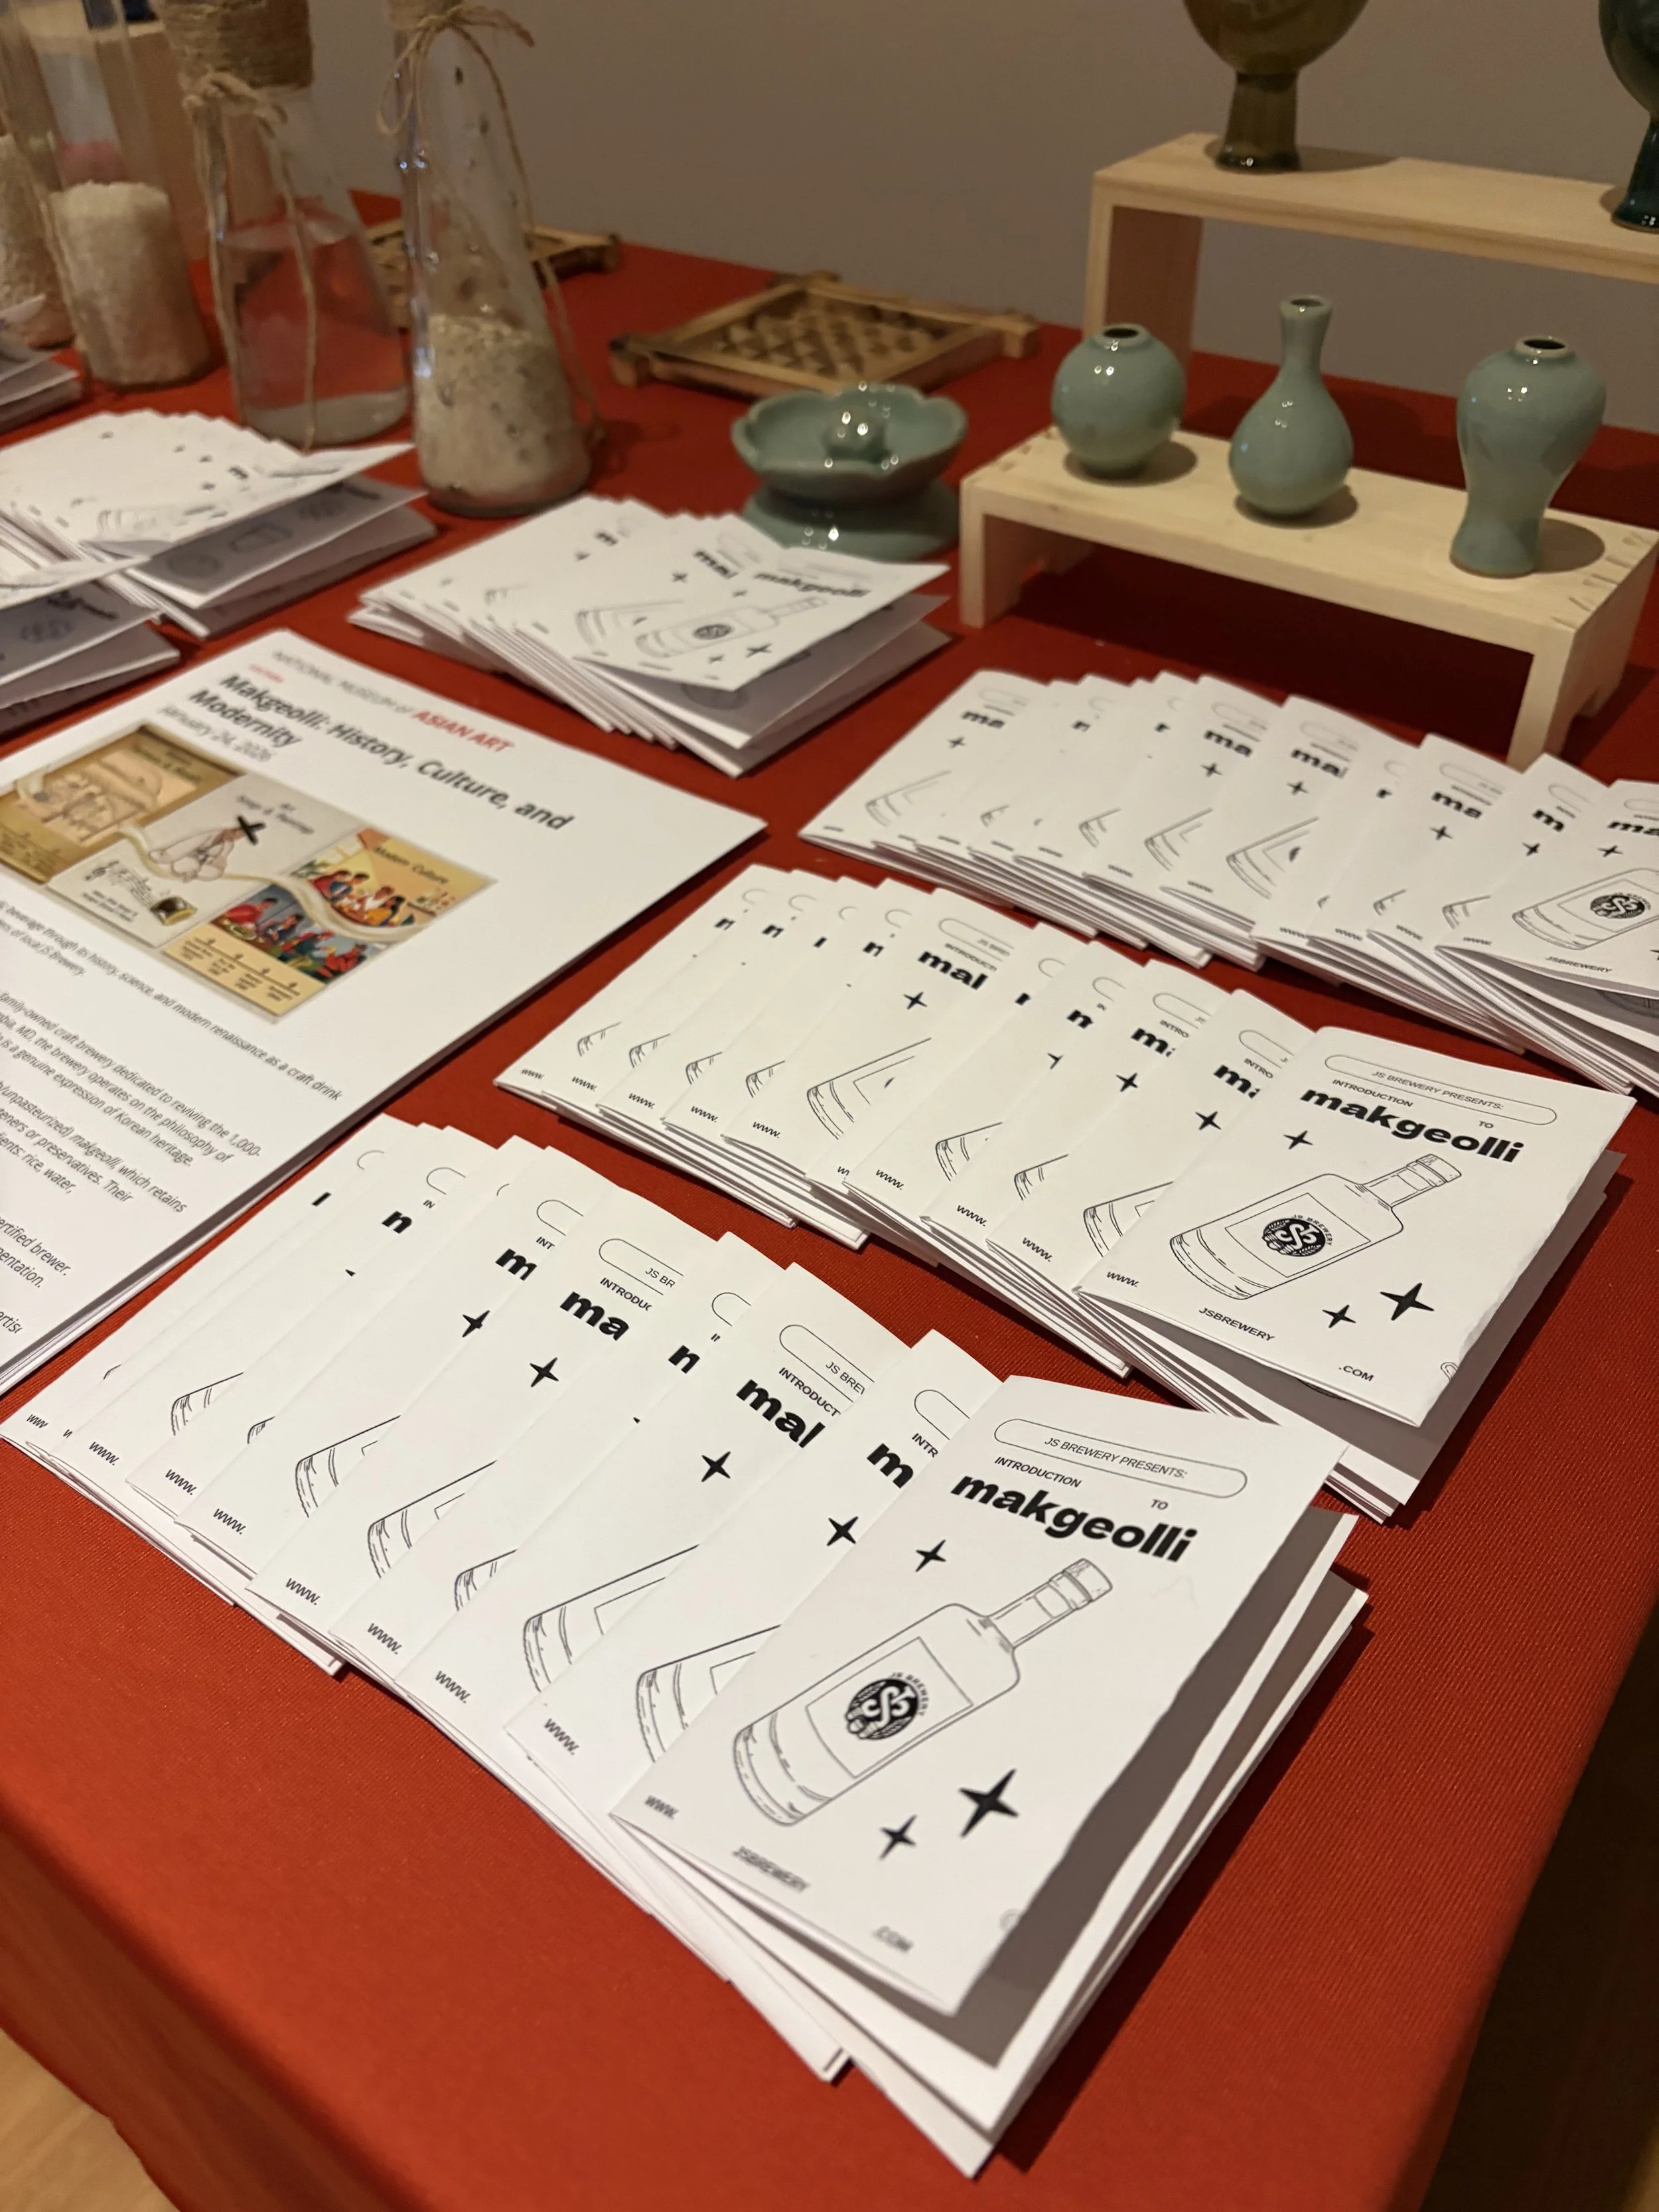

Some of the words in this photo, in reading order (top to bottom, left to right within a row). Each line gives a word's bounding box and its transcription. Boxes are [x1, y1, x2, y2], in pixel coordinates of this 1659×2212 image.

[188, 688, 303, 748] Modernity
[411, 710, 473, 738] ASIAN
[469, 732, 514, 752] ART
[220, 673, 330, 730] Makgeolli:
[325, 723, 414, 769] History,
[416, 759, 510, 810] Culture,
[514, 802, 575, 830] and
[411, 864, 450, 885] Culture
[1545, 956, 1613, 974] JSBREWERY
[42, 928, 79, 951] through
[86, 952, 119, 976] history,
[153, 993, 175, 1007] and
[172, 1001, 213, 1029] modern
[210, 1023, 267, 1060] renaissance
[265, 1055, 280, 1067] as
[277, 1062, 289, 1071] a
[286, 1067, 316, 1084] craft
[312, 1081, 343, 1101] drink
[9, 1045, 20, 1053] a
[12, 1049, 56, 1076] genuine
[15, 1024, 37, 1043] MD,
[35, 1037, 53, 1052] the
[50, 1045, 90, 1077] brewery
[87, 1071, 133, 1102] operates
[129, 1096, 146, 1112] on
[143, 1106, 163, 1122] the
[159, 1117, 218, 1157] philosophy
[214, 1150, 234, 1163] of
[53, 1072, 106, 1110] expression
[54, 1027, 79, 1045] craft
[75, 1039, 115, 1069] brewery
[113, 1063, 164, 1096] dedicated
[159, 1092, 173, 1104] to
[171, 1098, 212, 1129] reviving
[210, 1123, 230, 1138] the
[228, 1134, 260, 1157] 1,000-
[1331, 1078, 1413, 1108] INTRODUCTION
[1386, 1074, 1440, 1094] BREWERY
[1442, 1090, 1504, 1110] PRESENTS:
[103, 1104, 122, 1118] of
[114, 1112, 152, 1140] Korean
[690, 1104, 719, 1124] www.
[1299, 1088, 1525, 1163] makgeolli
[1479, 1120, 1494, 1130] TO
[25, 1128, 42, 1140] or
[752, 1120, 781, 1139] www.
[33, 1137, 104, 1187] preservatives.
[149, 1132, 194, 1168] heritage.
[21, 1152, 44, 1173] rice,
[43, 1168, 77, 1195] water,
[875, 1169, 904, 1191] www.
[103, 1179, 134, 1203] Their
[118, 1165, 151, 1190] which
[147, 1185, 188, 1213] retains
[957, 1204, 987, 1227] www.
[30, 1241, 72, 1277] brewer.
[1022, 1236, 1053, 1263] www.
[644, 1267, 660, 1279] JS
[1106, 1270, 1139, 1288] www.
[1198, 1307, 1275, 1342] JSBREWERY
[825, 1361, 841, 1375] JS
[1338, 1364, 1375, 1382] .COM
[89, 1441, 120, 1467] www.
[1045, 1437, 1061, 1447] JS
[1060, 1441, 1120, 1463] BREWERY
[1119, 1455, 1188, 1480] PRESENTS:
[165, 1468, 198, 1496] www.
[994, 1455, 1082, 1488] INTRODUCTION
[950, 1475, 1198, 1563] makgeolli
[1150, 1498, 1169, 1511] TO
[213, 1508, 247, 1535] www.
[285, 1577, 321, 1607] www.
[367, 1621, 403, 1655] www.
[434, 1670, 472, 1704] www.
[543, 1717, 581, 1756] www.
[644, 1794, 680, 1820] www.
[732, 1845, 810, 1892] JSBREWERY
